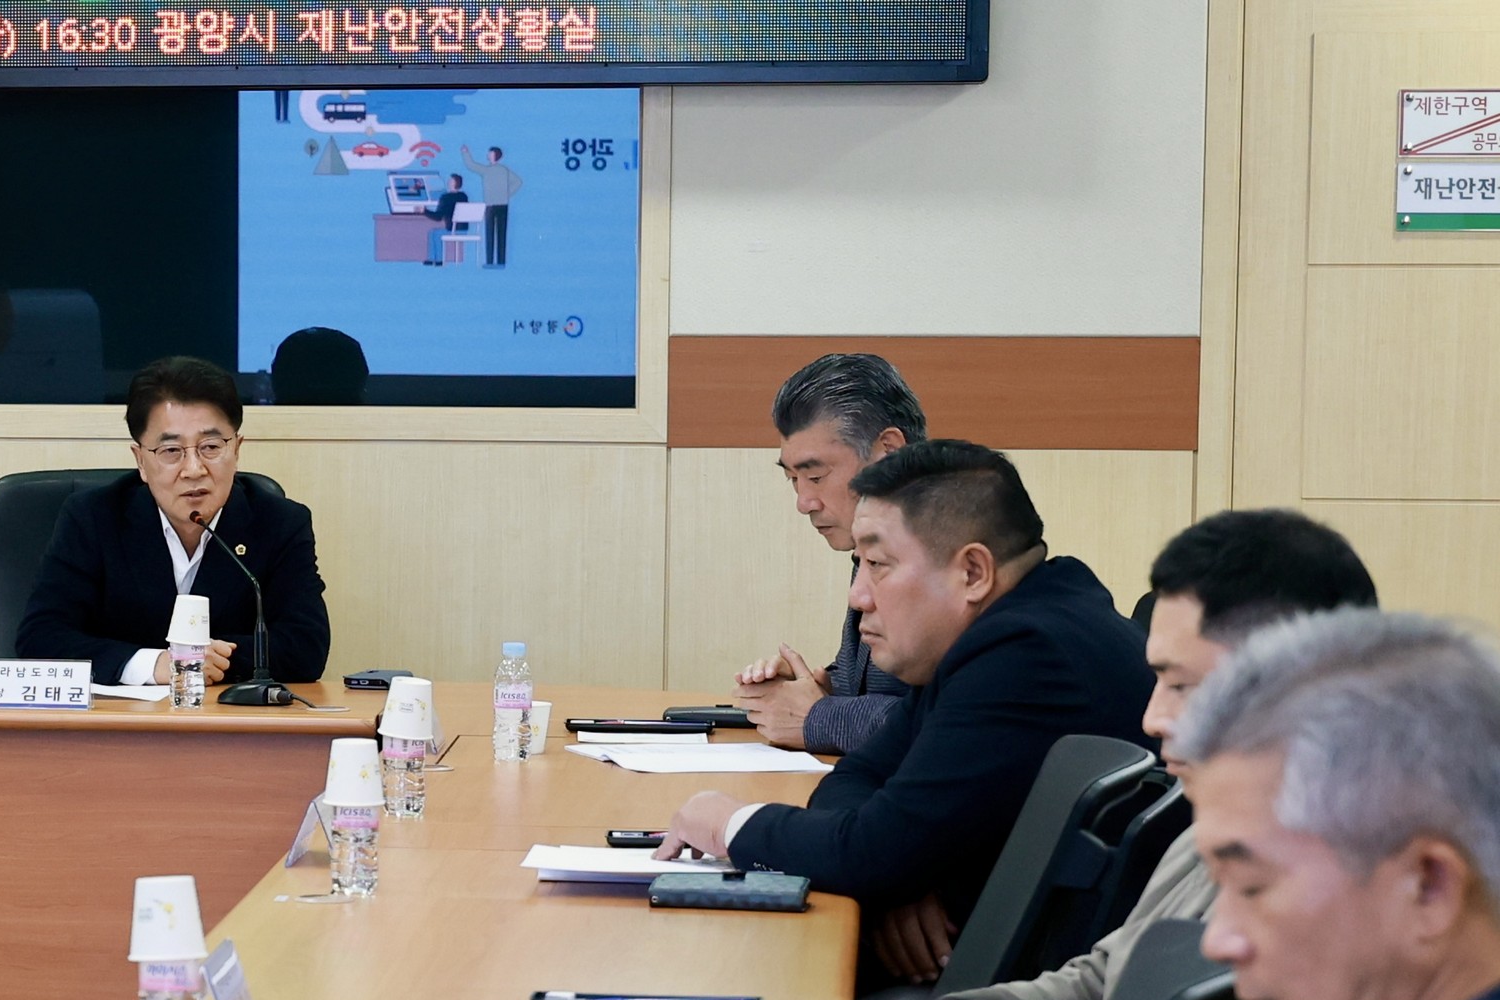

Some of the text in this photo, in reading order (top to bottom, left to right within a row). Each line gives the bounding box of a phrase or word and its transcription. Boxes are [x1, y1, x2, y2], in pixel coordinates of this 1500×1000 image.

[34, 17, 138, 52] 16:30
[152, 8, 276, 55] 광양시
[297, 6, 597, 53] 재난안전상황실
[1413, 95, 1488, 116] 제한구역
[1413, 176, 1500, 200] 재난안전
[21, 686, 85, 703] 김태균
